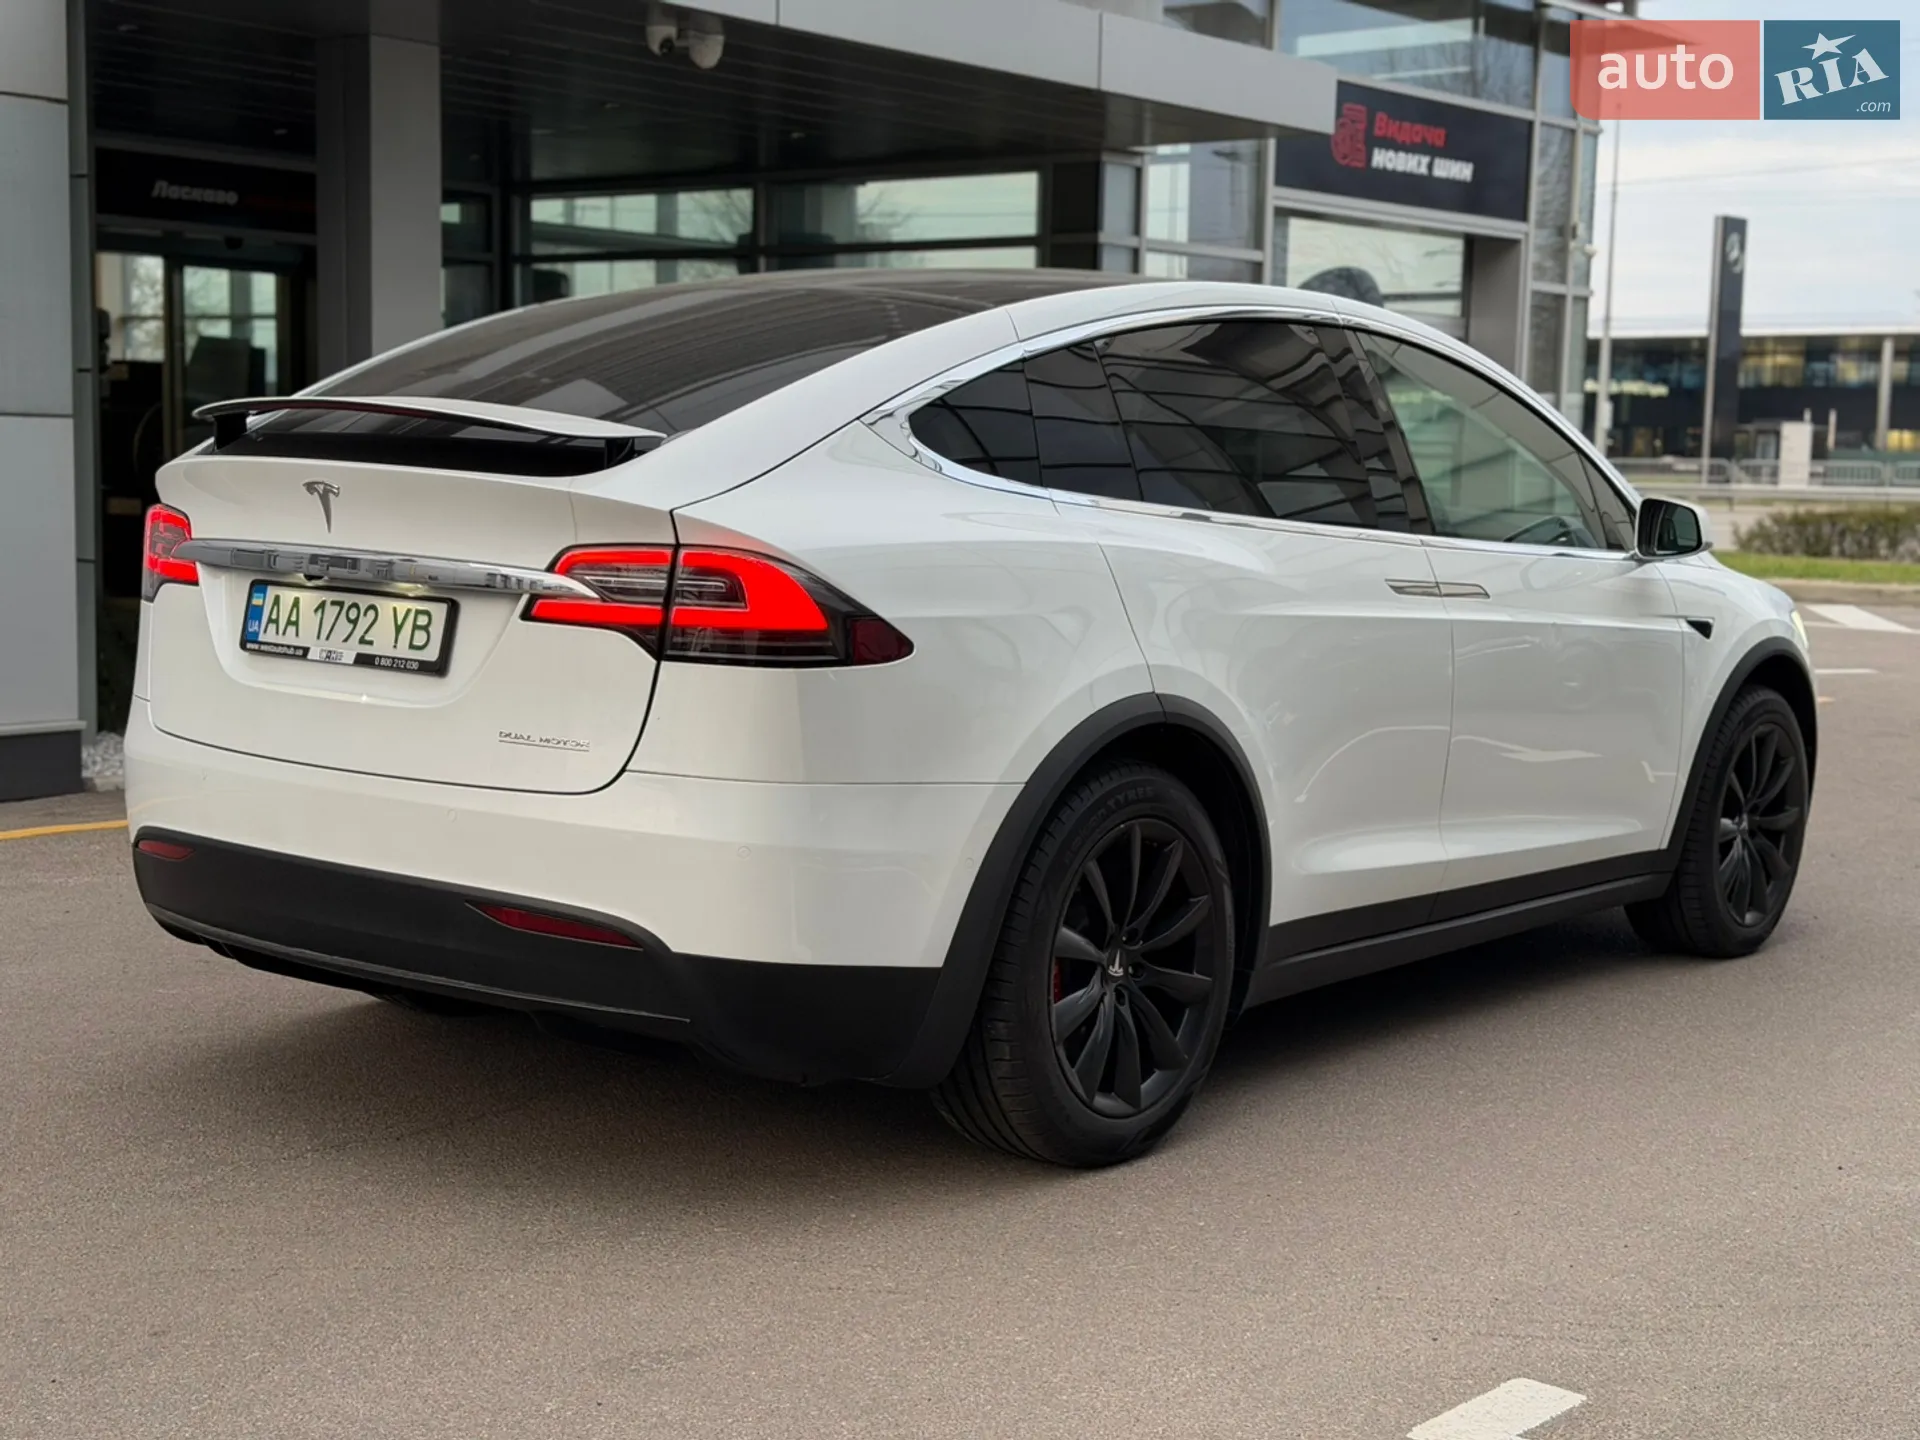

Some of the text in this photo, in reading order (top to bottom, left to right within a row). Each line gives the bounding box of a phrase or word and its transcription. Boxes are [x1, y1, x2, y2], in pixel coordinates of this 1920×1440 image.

[1374, 112, 1446, 147] Видача
[152, 180, 238, 205] Ласкаво
[248, 620, 259, 633] UA
[263, 594, 433, 651] AA 1792 YB
[375, 657, 419, 670] 0 800 212 030
[499, 731, 590, 748] DUAL MOTOR
